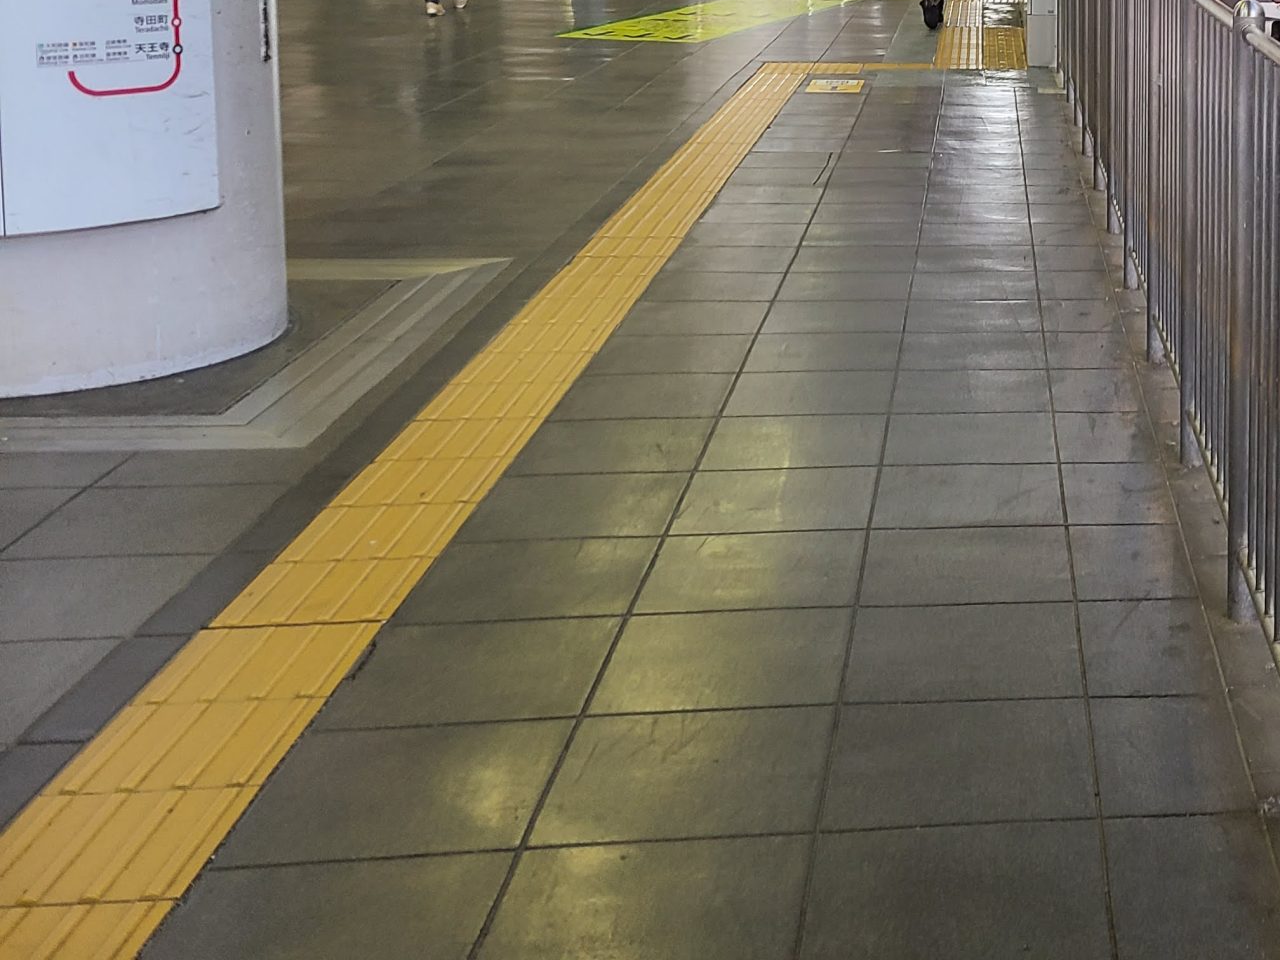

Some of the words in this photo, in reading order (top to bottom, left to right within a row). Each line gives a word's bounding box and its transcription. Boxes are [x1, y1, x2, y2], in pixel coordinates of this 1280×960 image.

[133, 15, 169, 27] 寺田町
[134, 42, 170, 54] 天王寺
